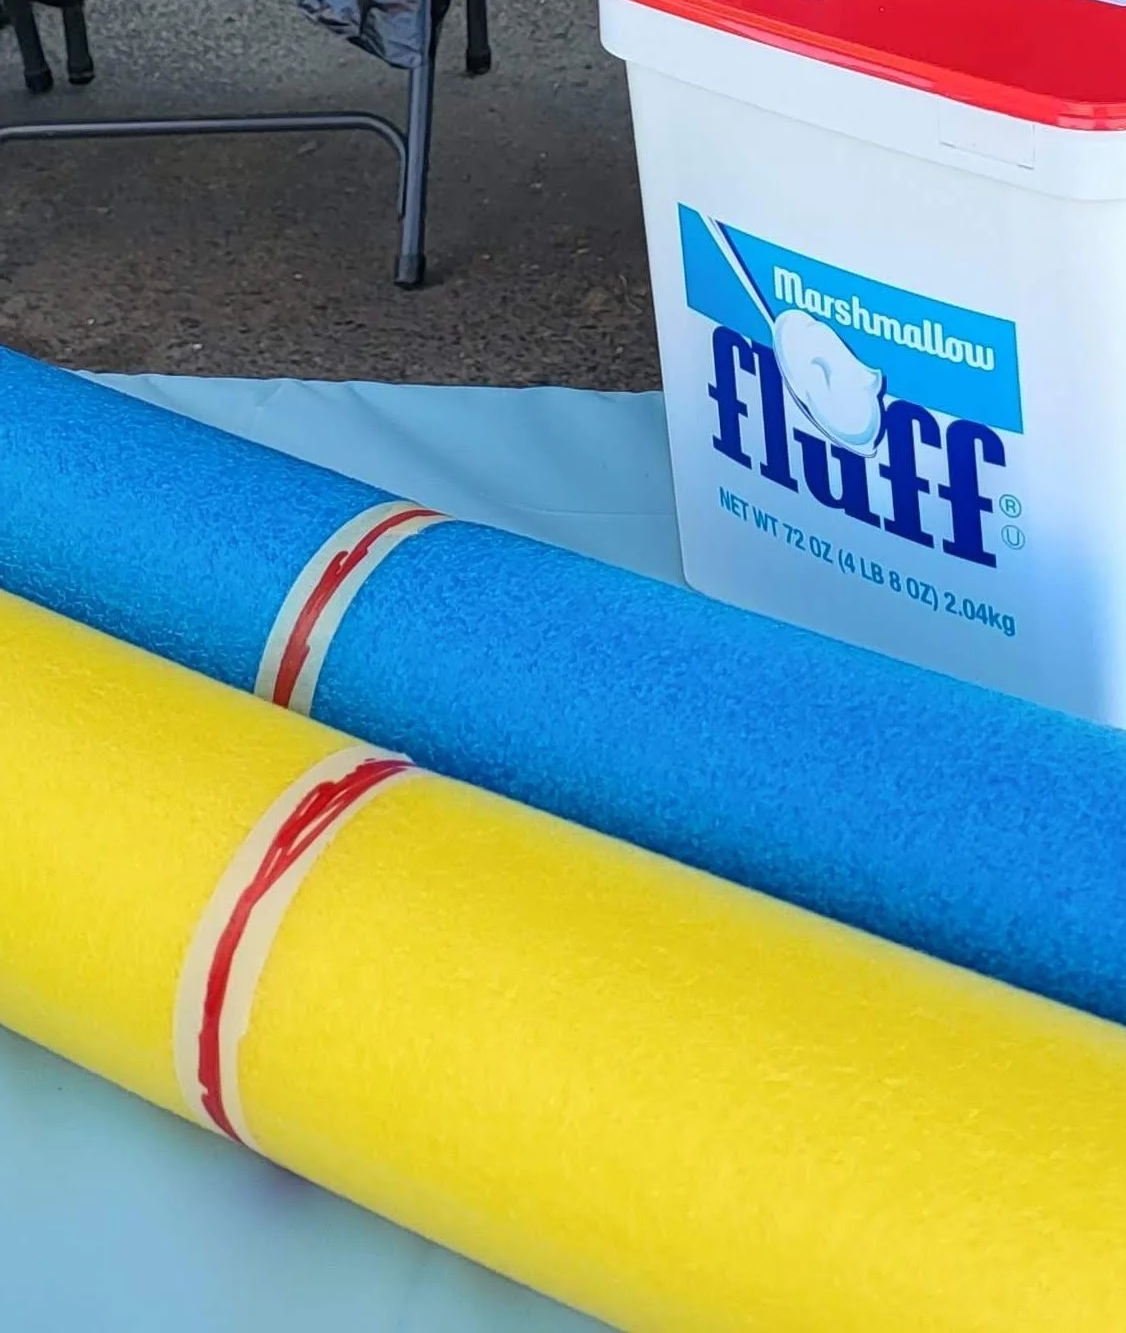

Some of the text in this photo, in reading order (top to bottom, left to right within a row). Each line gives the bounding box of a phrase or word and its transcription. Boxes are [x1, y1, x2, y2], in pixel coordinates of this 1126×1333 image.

[772, 264, 996, 372] Marshmallow
[708, 325, 1007, 569] fluff
[719, 486, 1016, 637] NET WT 72 OZ (4 LB 8 OZ) 2.04kg
